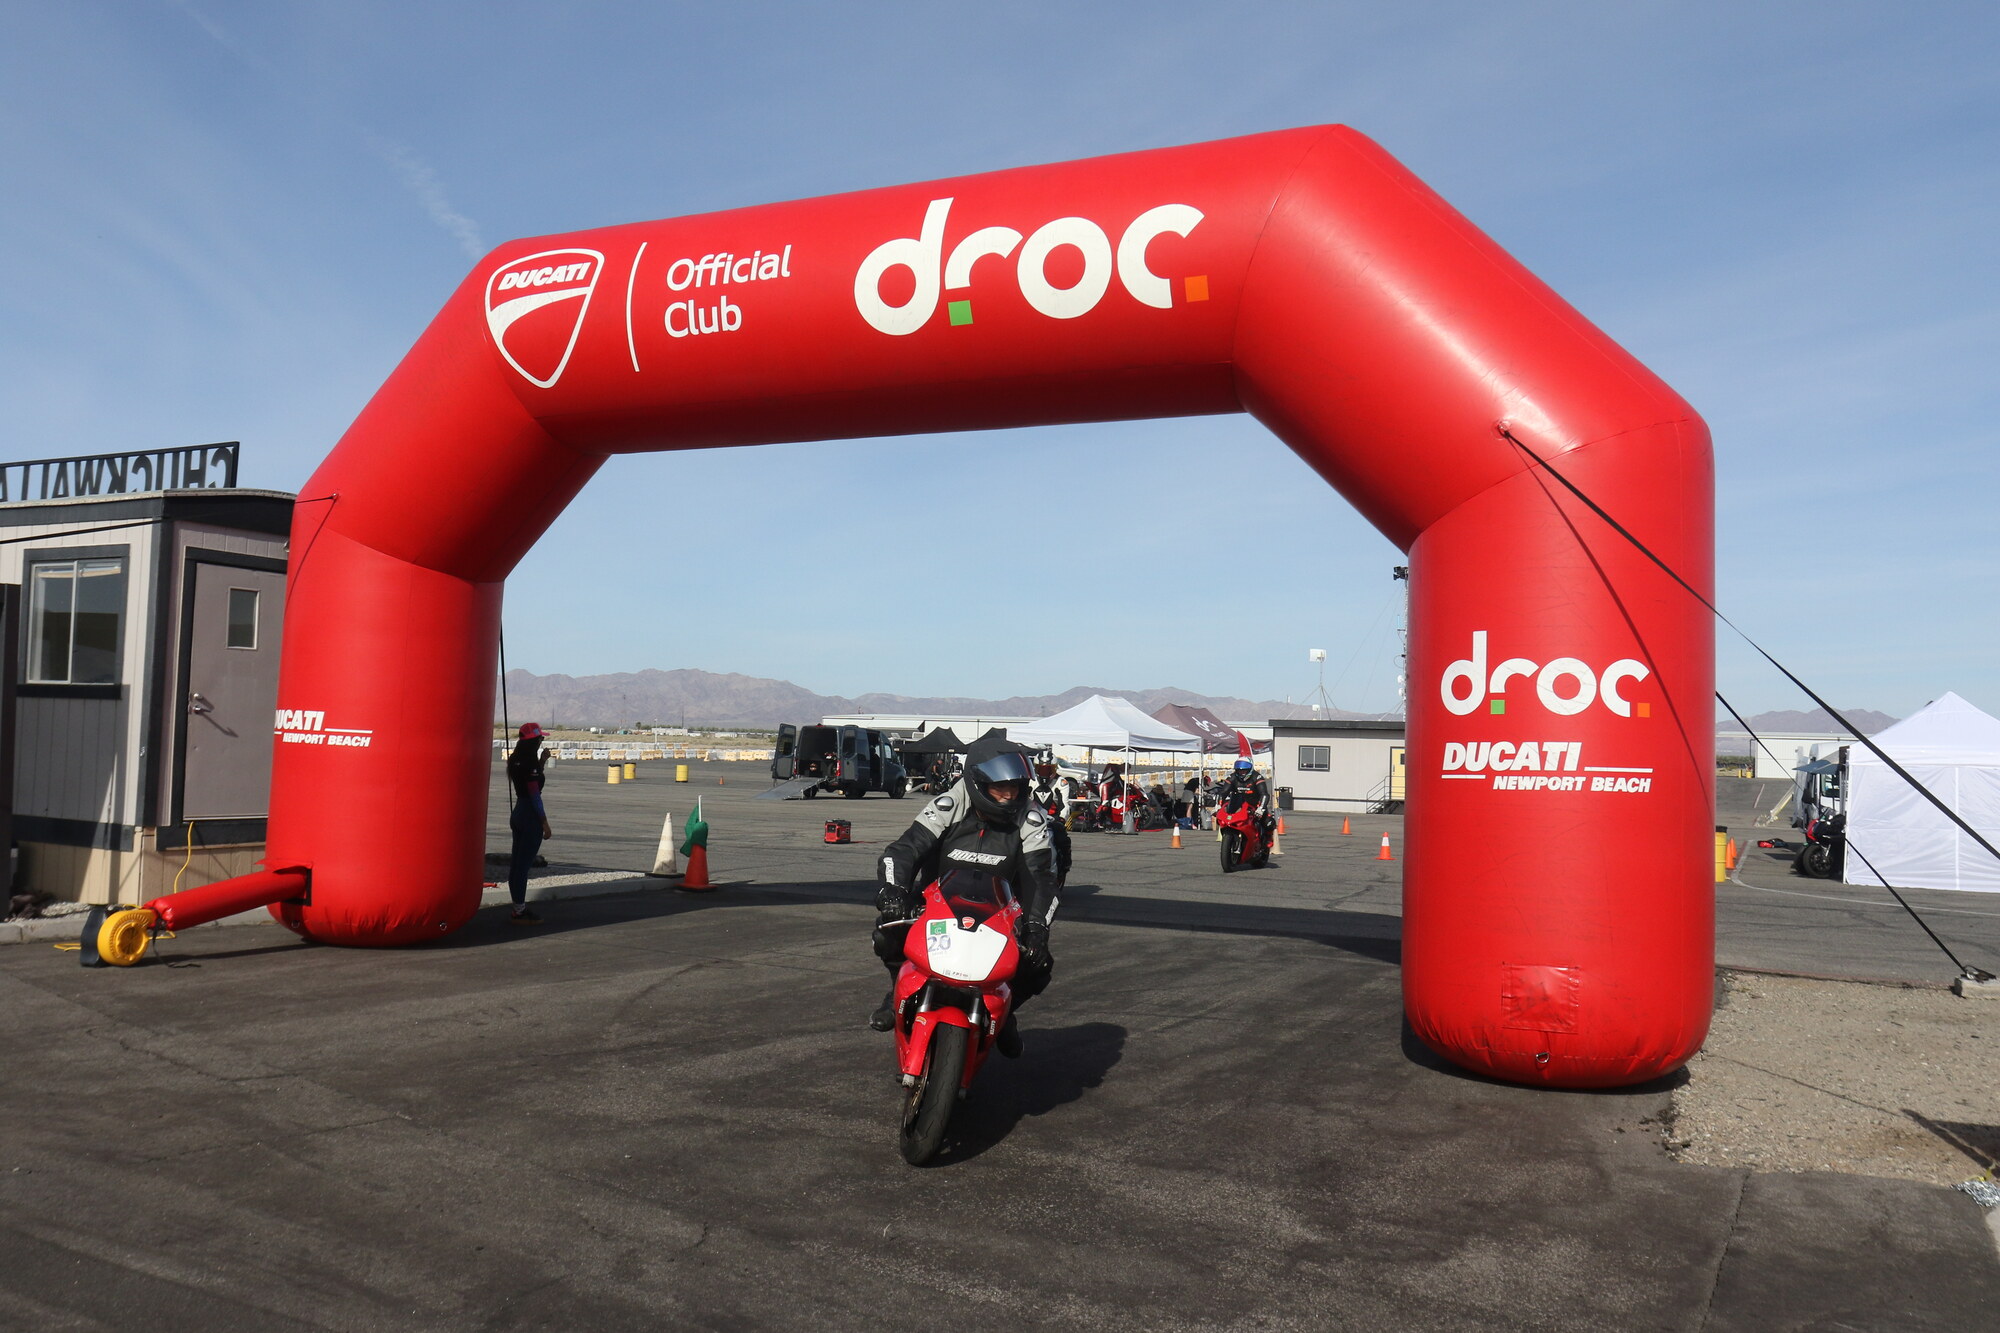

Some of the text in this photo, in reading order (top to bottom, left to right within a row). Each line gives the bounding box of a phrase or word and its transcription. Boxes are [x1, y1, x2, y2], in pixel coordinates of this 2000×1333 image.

[498, 262, 592, 291] DUCATI
[666, 244, 792, 292] Official
[664, 295, 742, 338] Club
[283, 732, 372, 747] NEWPORT BEACH
[1442, 741, 1583, 772] DUCATI
[1492, 775, 1652, 793] NEWPORT BEACH
